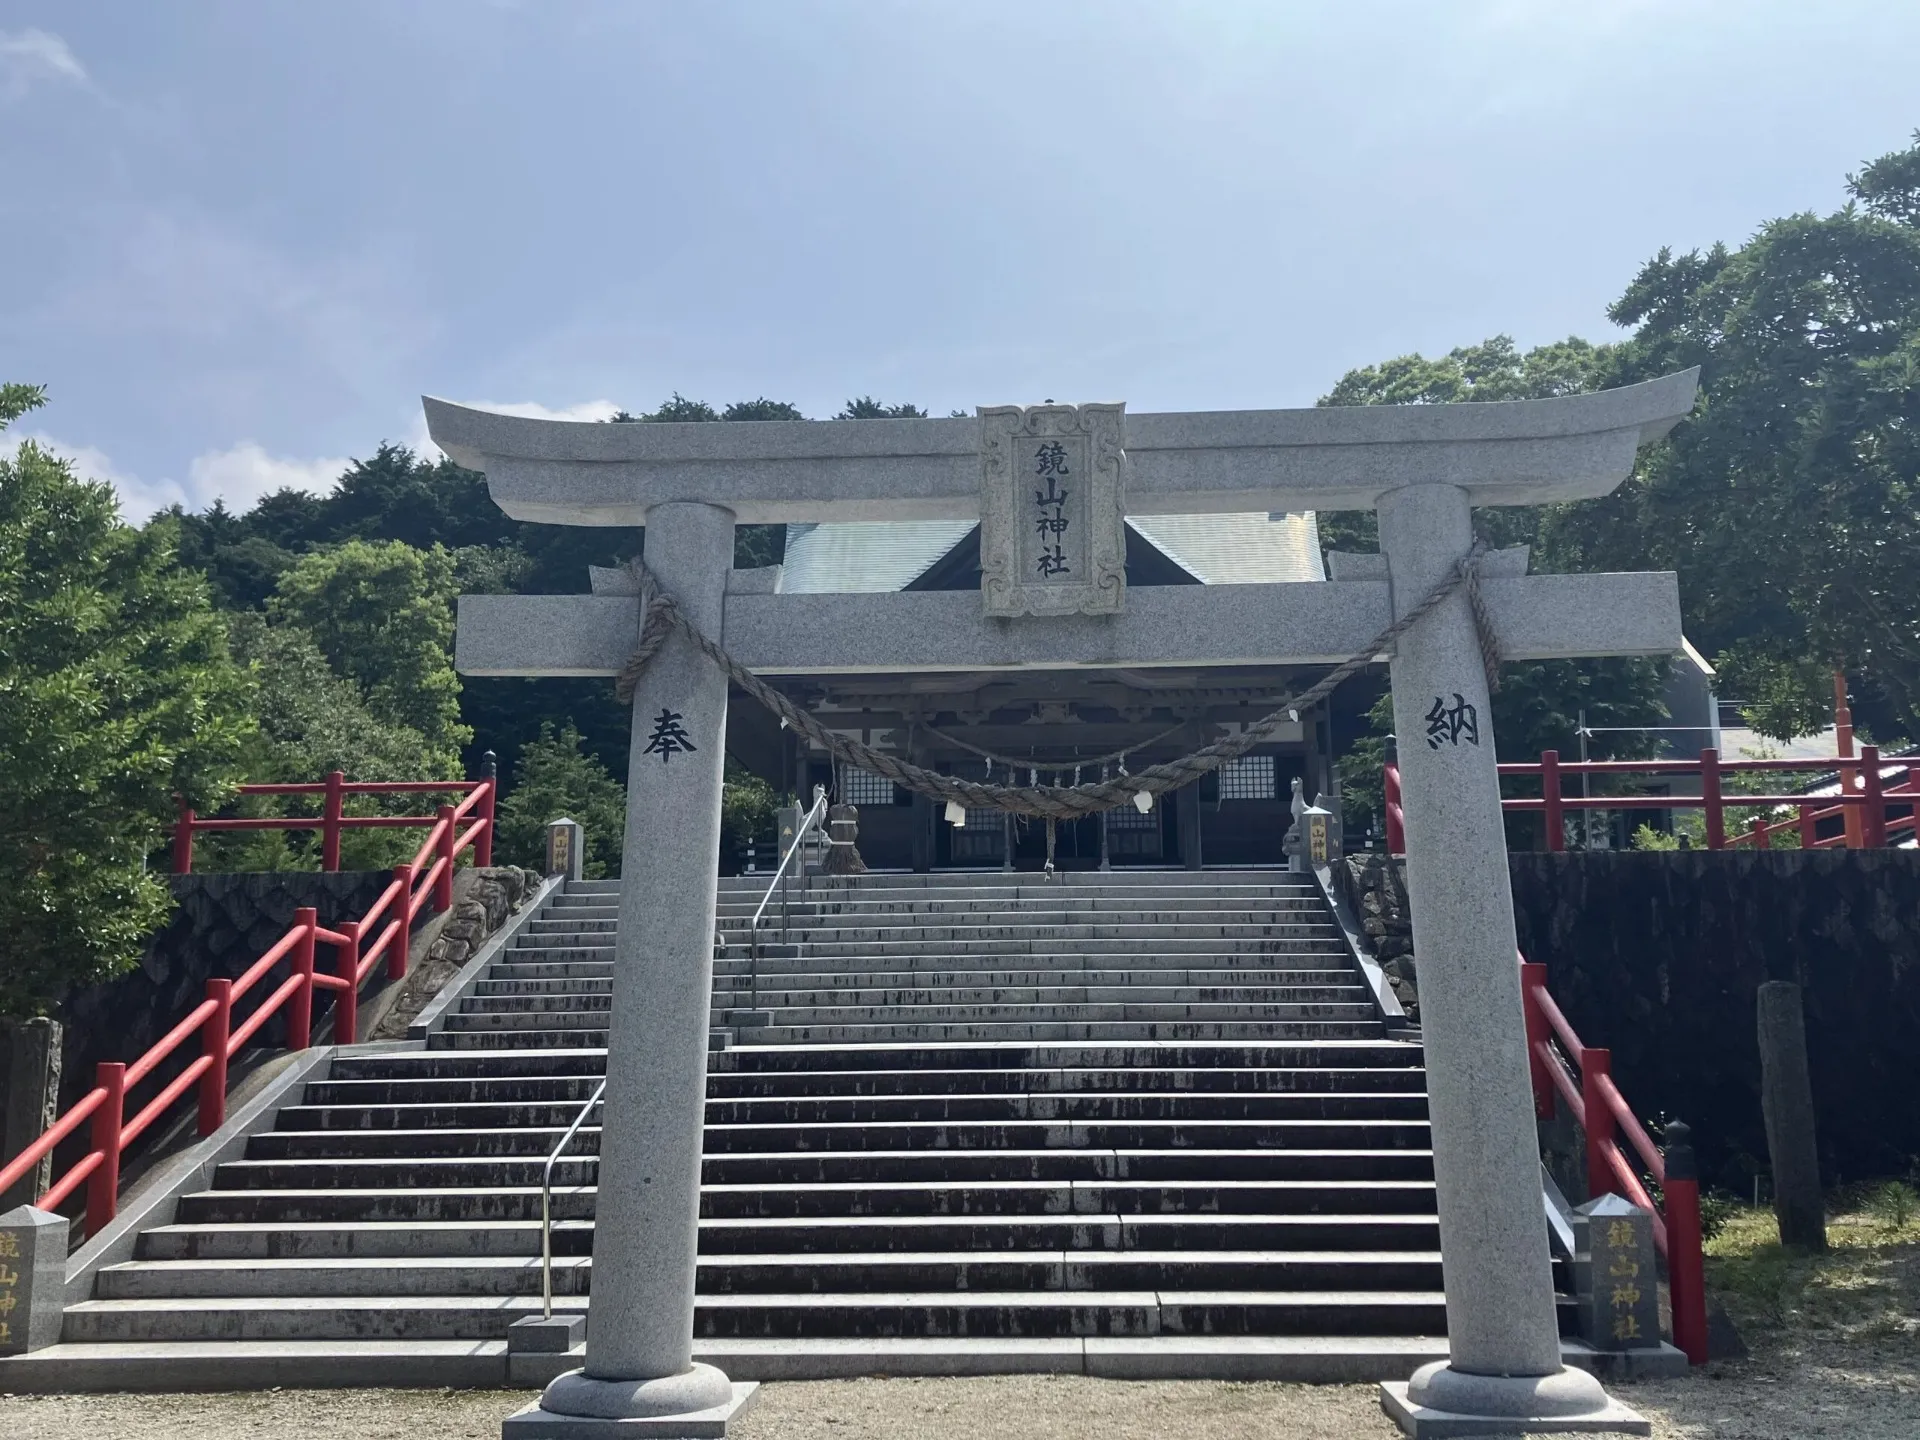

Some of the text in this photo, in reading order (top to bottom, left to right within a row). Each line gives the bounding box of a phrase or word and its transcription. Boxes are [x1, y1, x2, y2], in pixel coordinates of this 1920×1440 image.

[1034, 440, 1071, 579] 鏡山神社
[643, 708, 698, 764] 奉
[1424, 693, 1479, 750] 納
